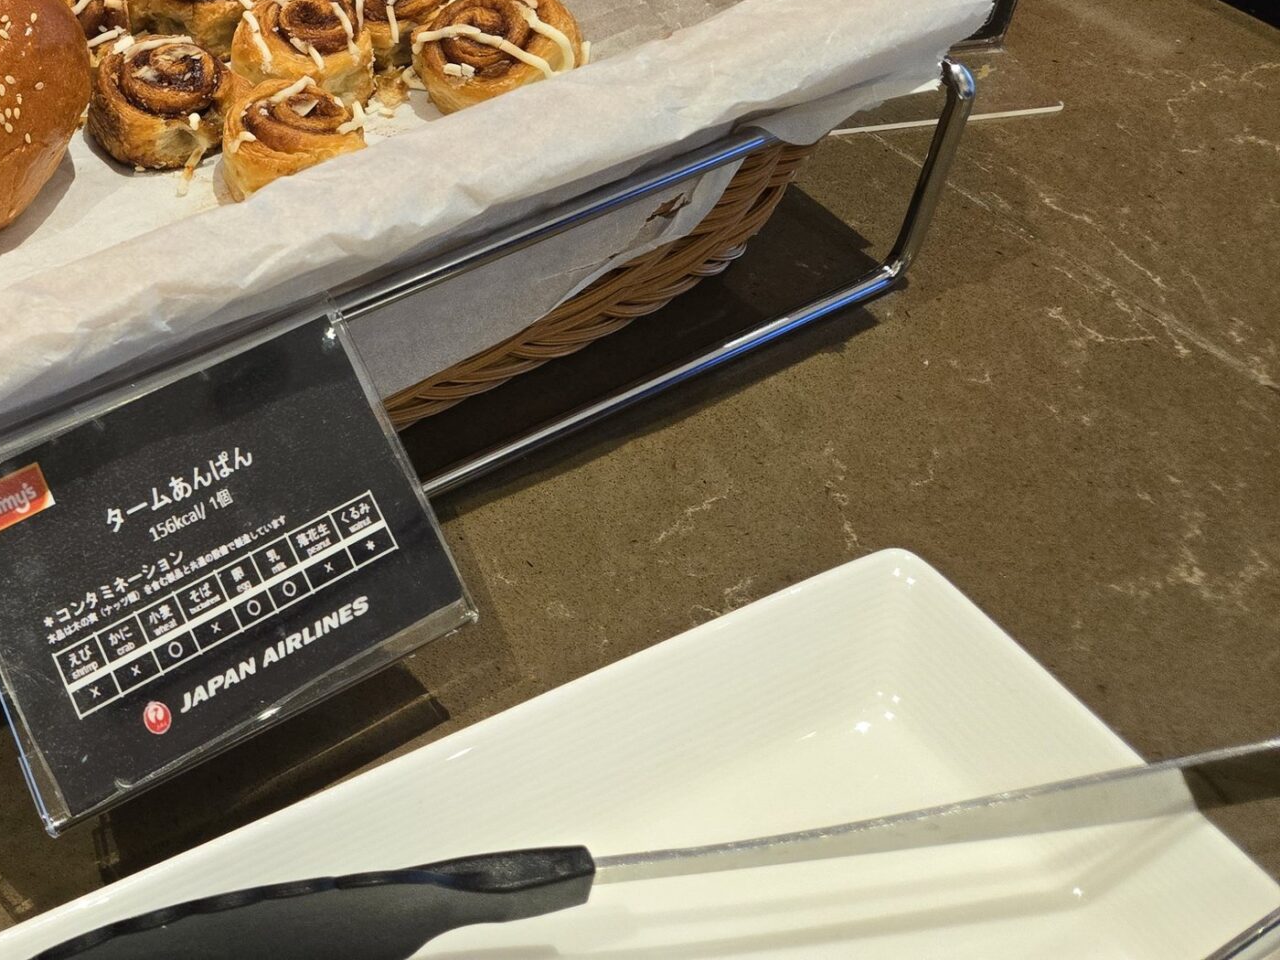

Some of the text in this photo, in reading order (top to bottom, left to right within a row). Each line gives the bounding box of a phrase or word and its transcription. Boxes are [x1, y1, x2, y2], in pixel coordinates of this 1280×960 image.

[106, 447, 253, 533] タームあんぱん
[341, 502, 370, 523] くるみ
[296, 523, 331, 548] 落花生
[189, 582, 213, 603] そば
[149, 604, 174, 624] 小麦
[108, 626, 133, 646] かに
[153, 618, 178, 637] wheat
[68, 645, 92, 668] えび
[116, 642, 135, 656] crab
[180, 595, 369, 714] JAPAN AIRLINES
[71, 661, 99, 680] shrimp
